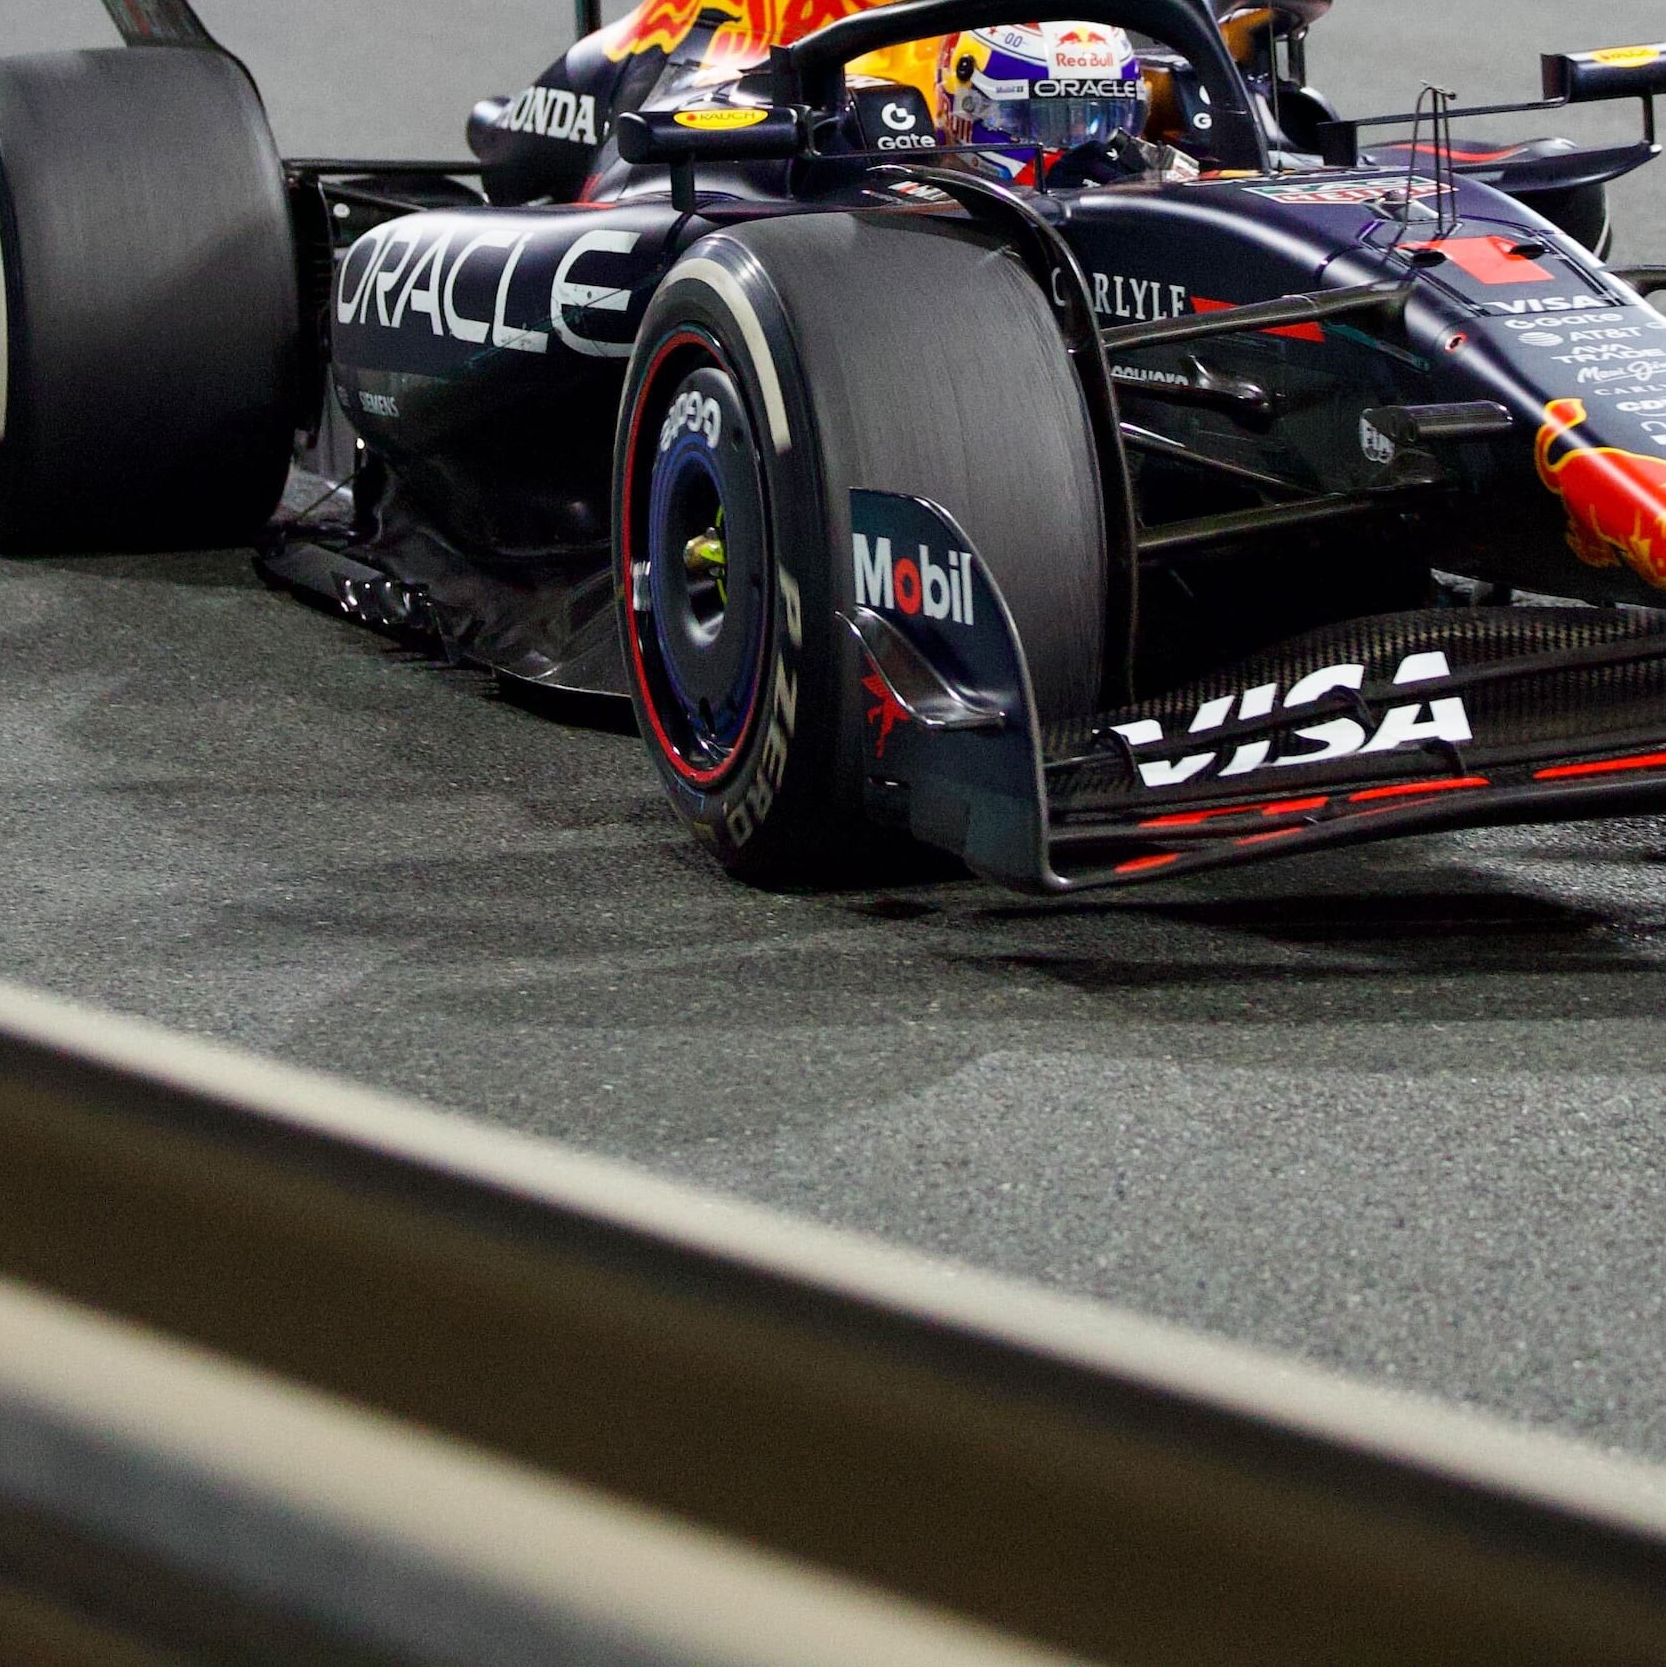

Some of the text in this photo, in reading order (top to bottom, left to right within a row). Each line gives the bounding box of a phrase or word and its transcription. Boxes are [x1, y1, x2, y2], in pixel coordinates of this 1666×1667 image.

[1056, 53, 1114, 67] Red Bull
[1034, 79, 1136, 98] ORACLE
[699, 112, 756, 122] RAUCH
[877, 133, 936, 151] Gate
[336, 218, 641, 359] ORACLE
[1051, 267, 1186, 322] CRLYLE
[1483, 294, 1610, 313] VISA
[1536, 313, 1624, 328] Gate
[1569, 326, 1642, 342] AT&T
[1571, 343, 1634, 355] AVA
[852, 532, 974, 627] Mobil
[1094, 650, 1473, 787] VISA
